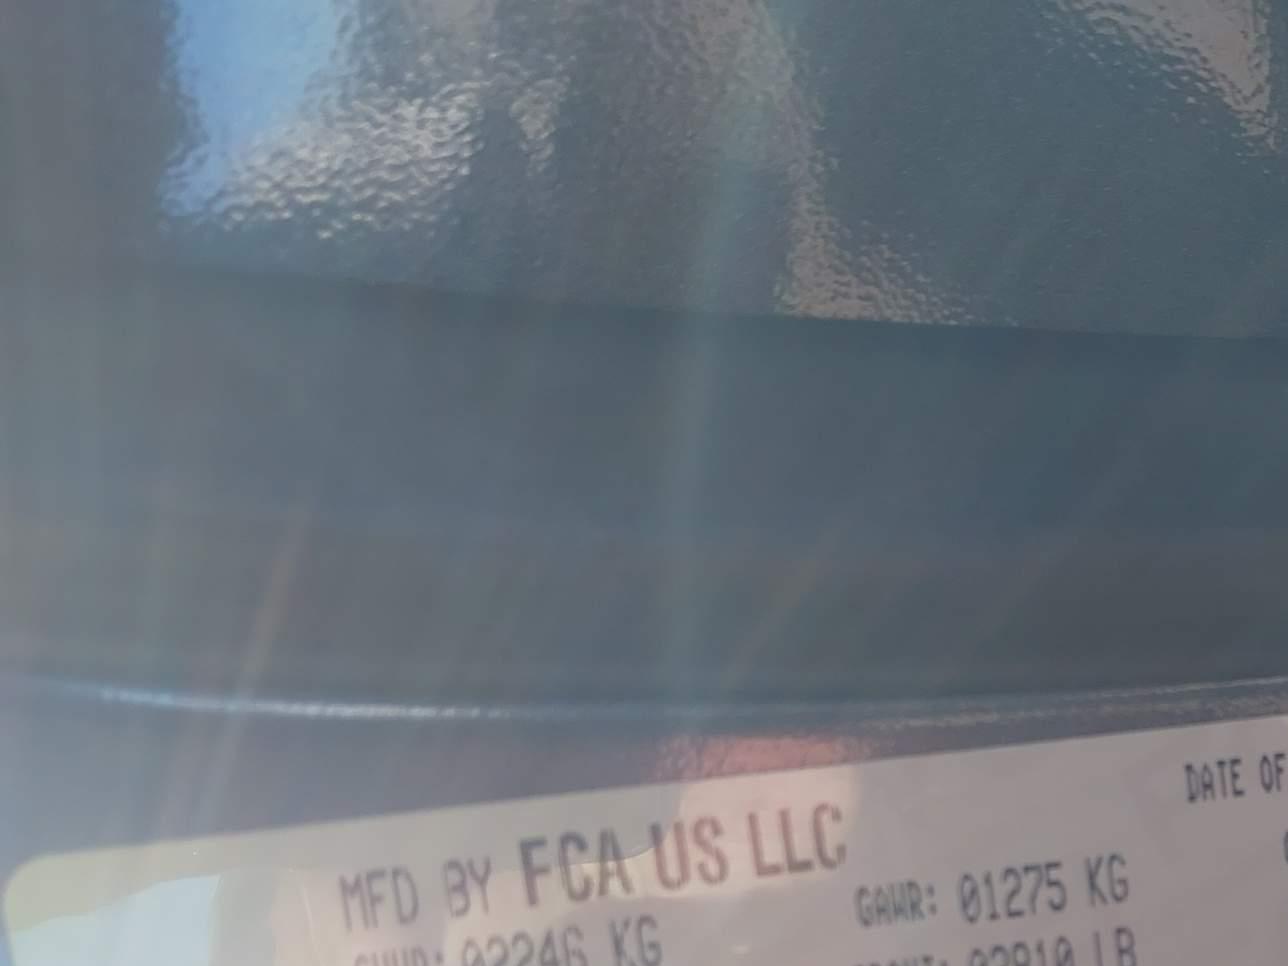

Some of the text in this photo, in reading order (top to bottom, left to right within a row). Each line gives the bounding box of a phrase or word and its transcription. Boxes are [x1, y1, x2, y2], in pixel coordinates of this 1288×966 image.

[1184, 758, 1246, 804] DATE
[1259, 752, 1288, 793] OF
[338, 802, 849, 932] MFD BY FCA US LLC
[854, 853, 1130, 928] GAWR: 01275 KG
